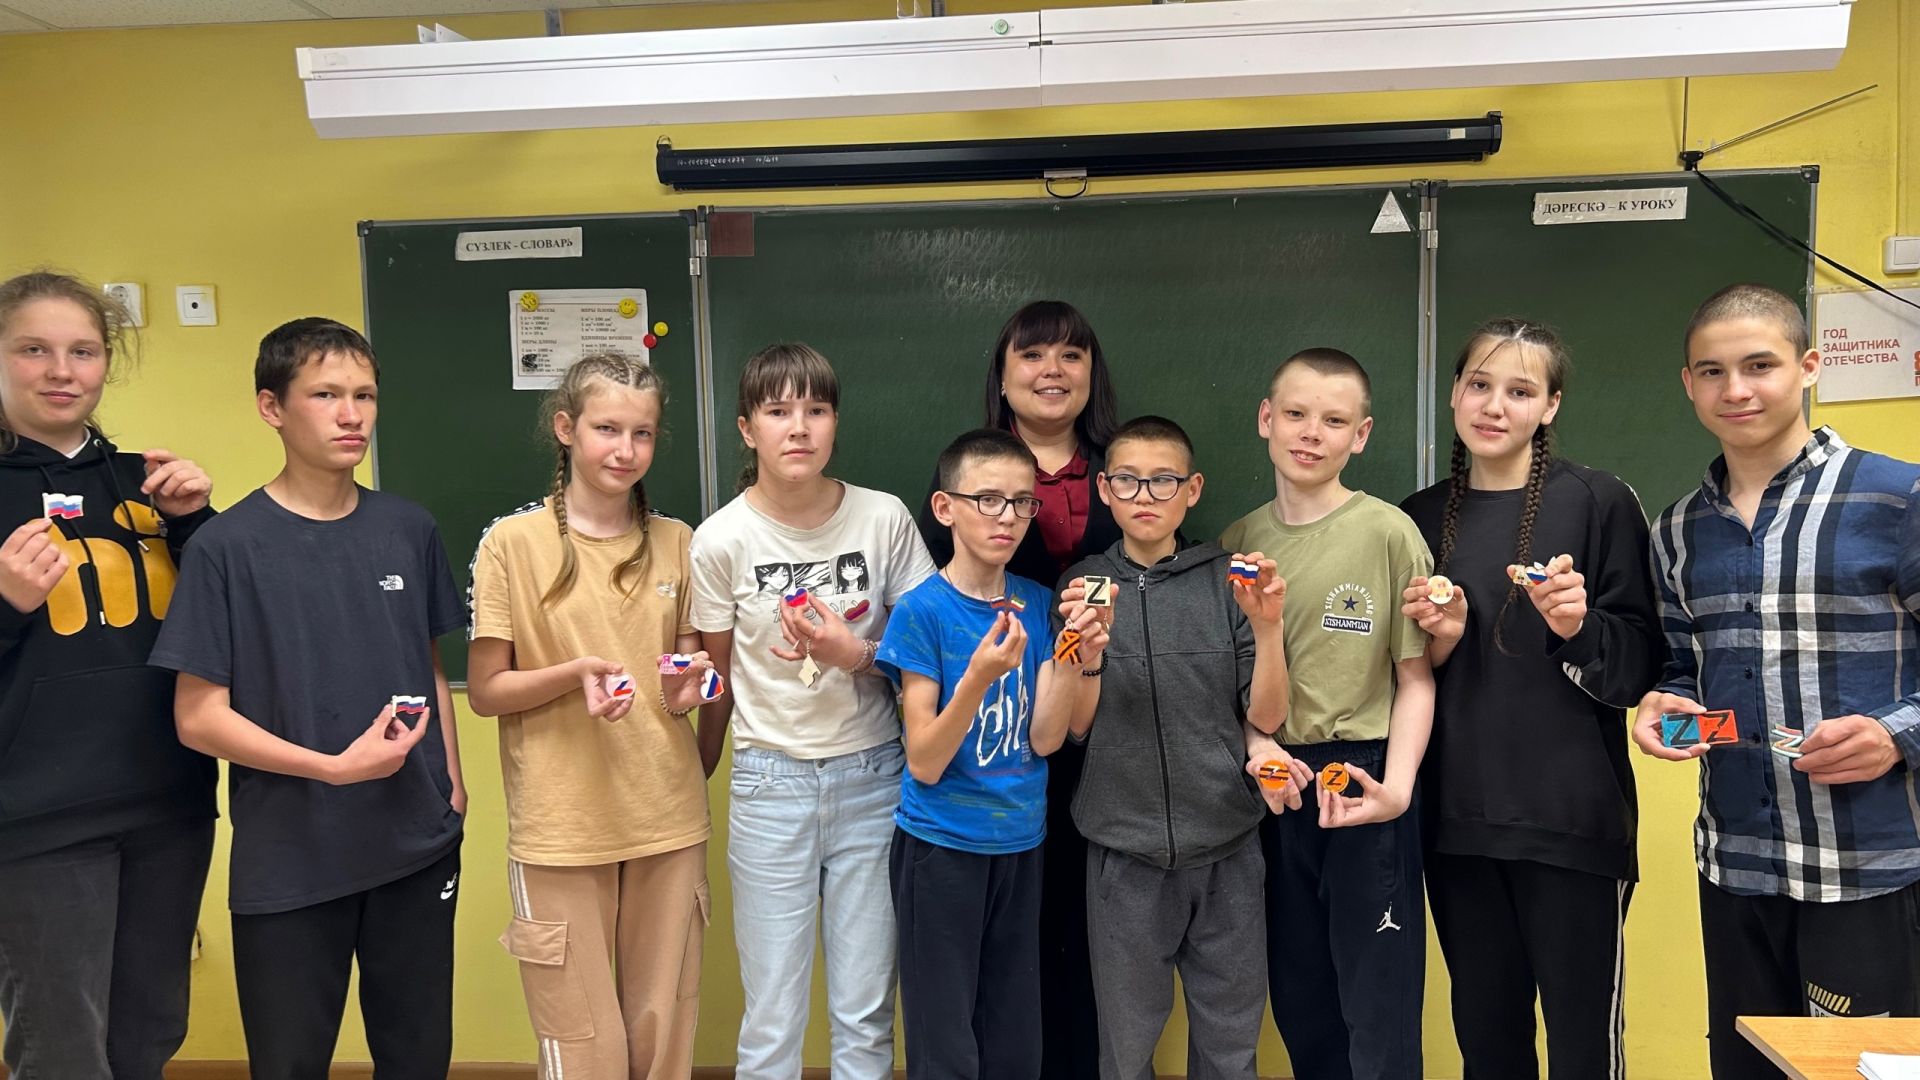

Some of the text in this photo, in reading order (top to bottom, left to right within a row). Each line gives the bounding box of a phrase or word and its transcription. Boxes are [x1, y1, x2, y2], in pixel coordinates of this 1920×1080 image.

[1542, 201, 1606, 215] ДӘРЕСКӘ
[1618, 201, 1628, 211] К
[1631, 199, 1677, 210] УРОКУ
[520, 238, 573, 250] СЛОВАРЬ
[1823, 328, 1848, 339] ГОД
[1823, 339, 1901, 352] ЗАЩИТНИКА
[1823, 352, 1899, 367] ОТЕЧЕСТВА
[1085, 576, 1107, 604] Z
[662, 655, 672, 665] Я
[1666, 713, 1700, 746] Z
[1703, 712, 1730, 743] Z
[1326, 769, 1344, 786] Z
